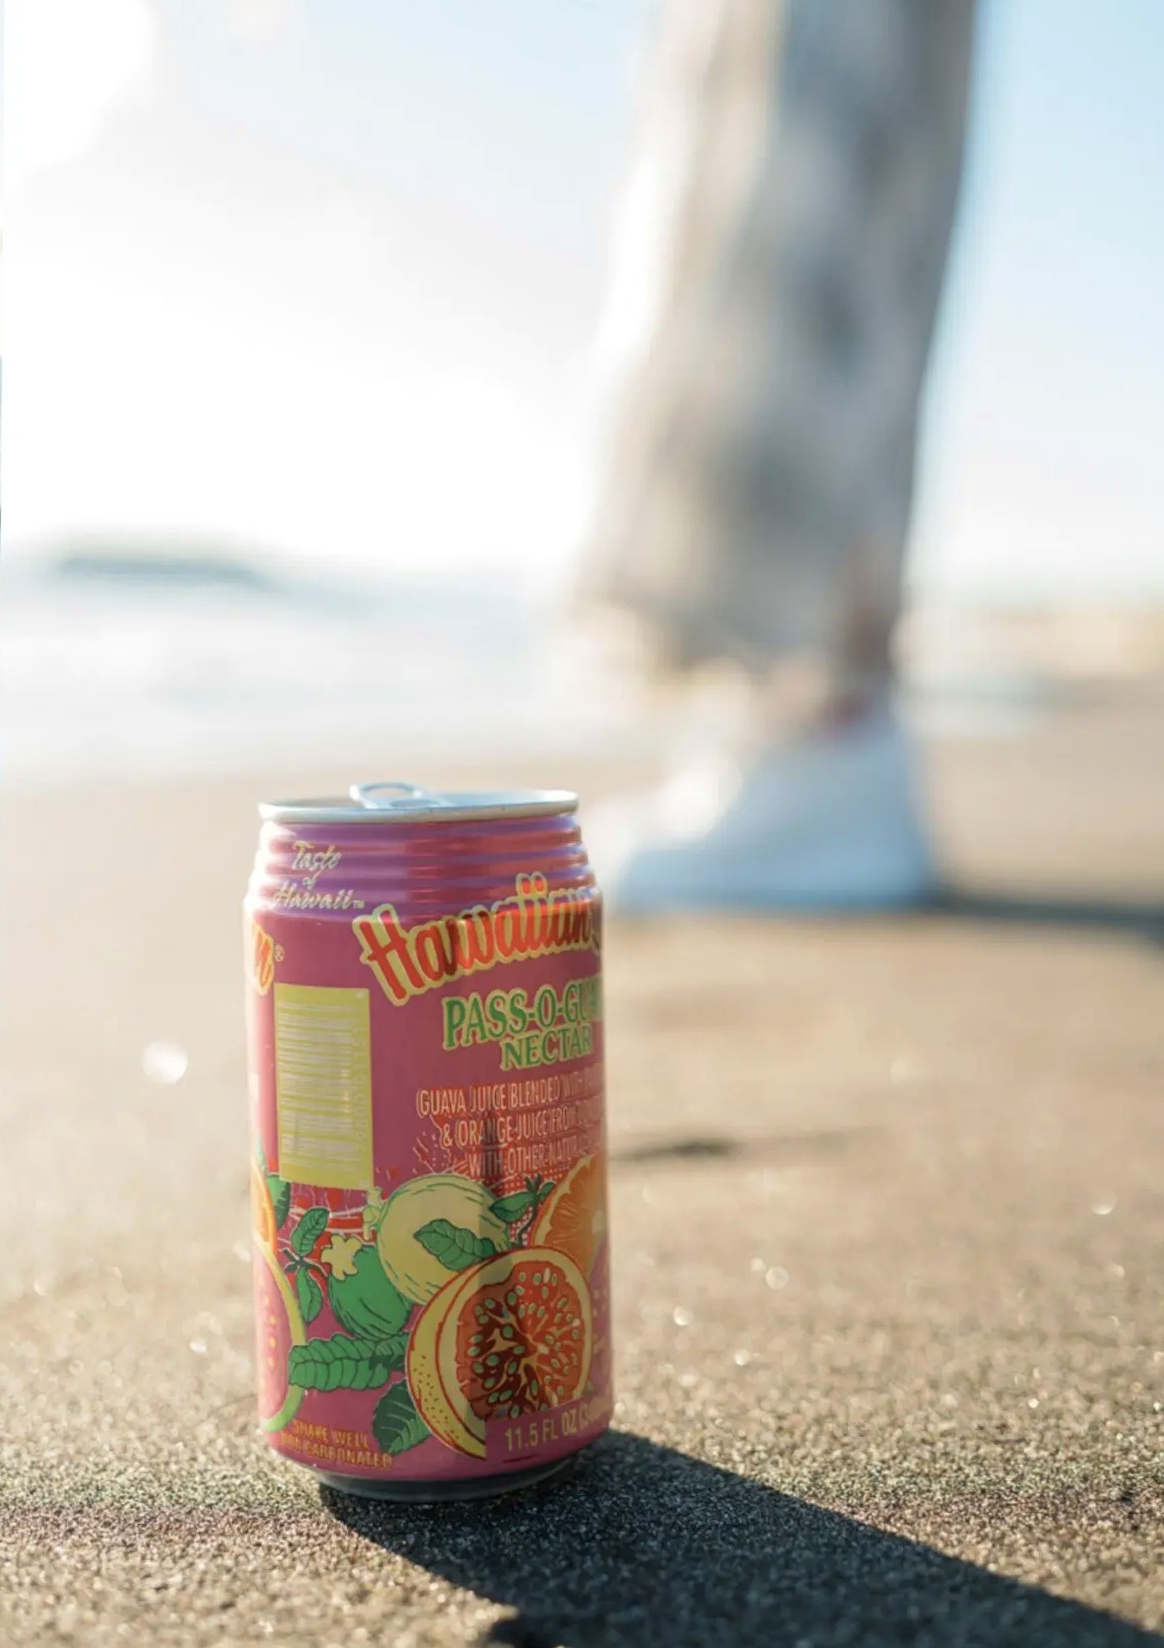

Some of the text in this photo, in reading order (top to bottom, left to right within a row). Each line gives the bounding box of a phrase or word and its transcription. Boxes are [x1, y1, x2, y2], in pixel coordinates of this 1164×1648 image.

[292, 840, 342, 871] Taste
[499, 1022, 594, 1071] NECTAR
[416, 1088, 467, 1118] (GUAVA
[470, 1084, 507, 1113] JUICE
[509, 1075, 560, 1109] BLENDED
[440, 1123, 454, 1150] &
[516, 1109, 548, 1140] JUICE
[468, 1149, 503, 1178] WITH
[506, 1144, 544, 1175] OTHER
[331, 1428, 369, 1449] WELL
[504, 1422, 539, 1452] 11.5
[542, 1419, 559, 1444] FL
